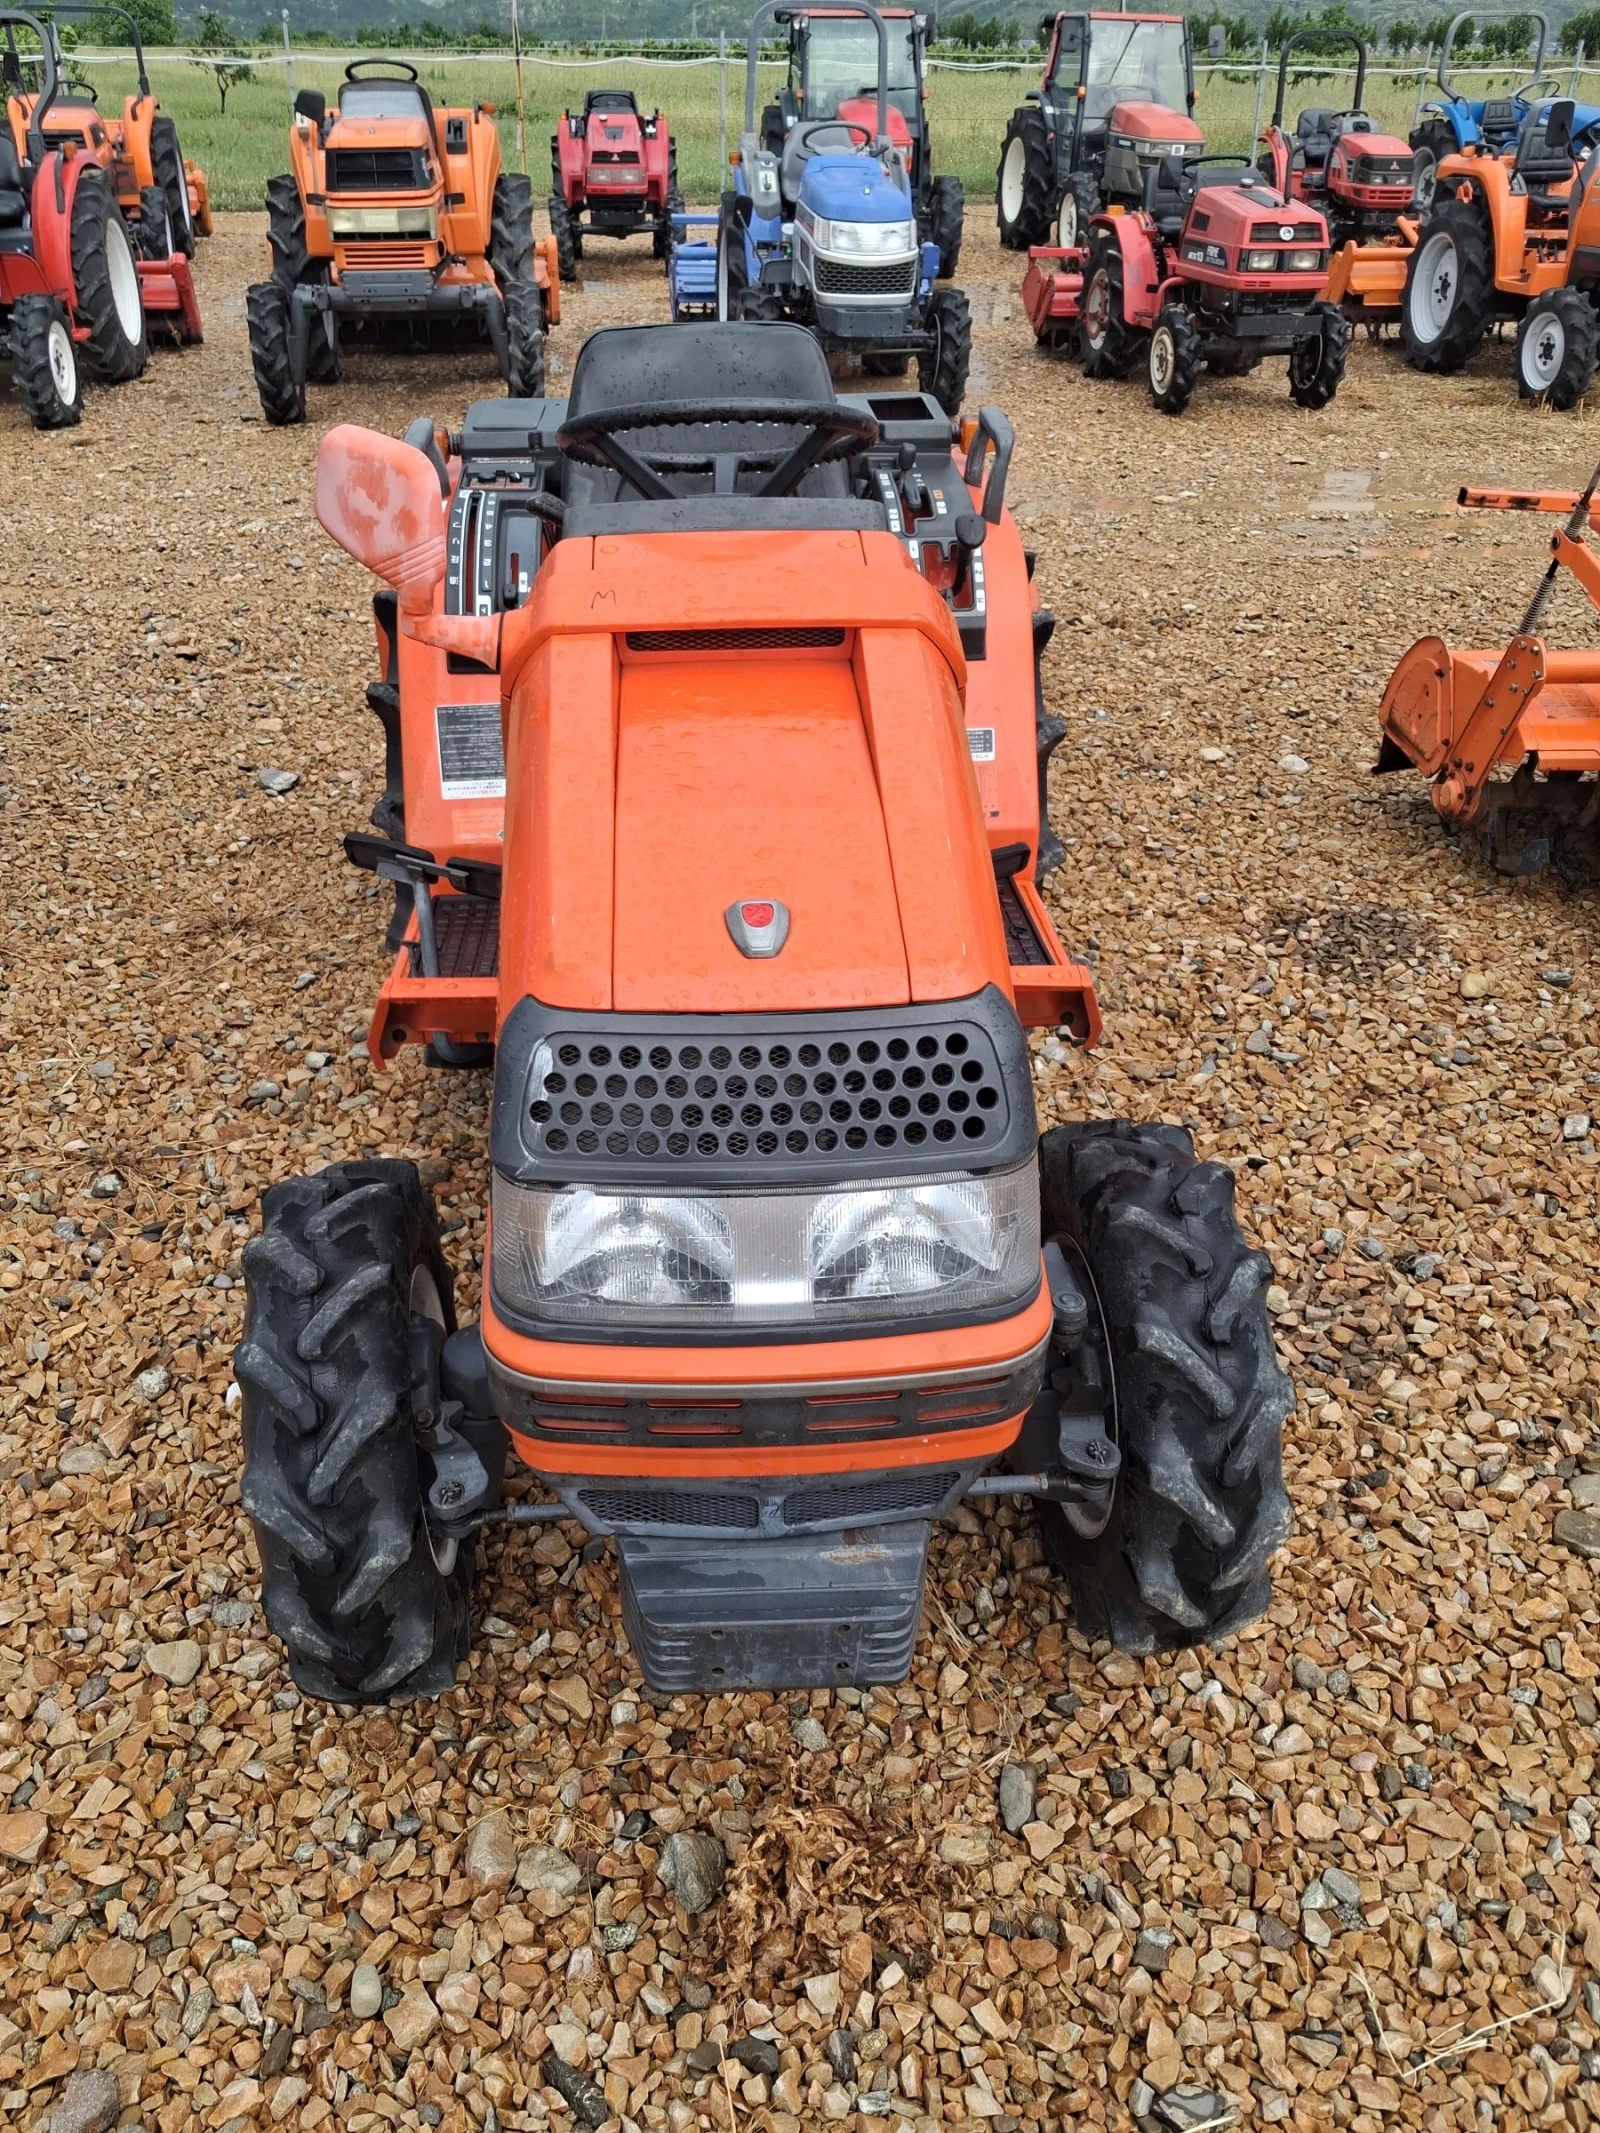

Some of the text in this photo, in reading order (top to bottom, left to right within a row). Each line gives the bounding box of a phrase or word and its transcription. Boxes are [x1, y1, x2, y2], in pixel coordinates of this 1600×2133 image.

[483, 559, 491, 567] 2
[484, 580, 489, 589] 1
[591, 589, 618, 610] M
